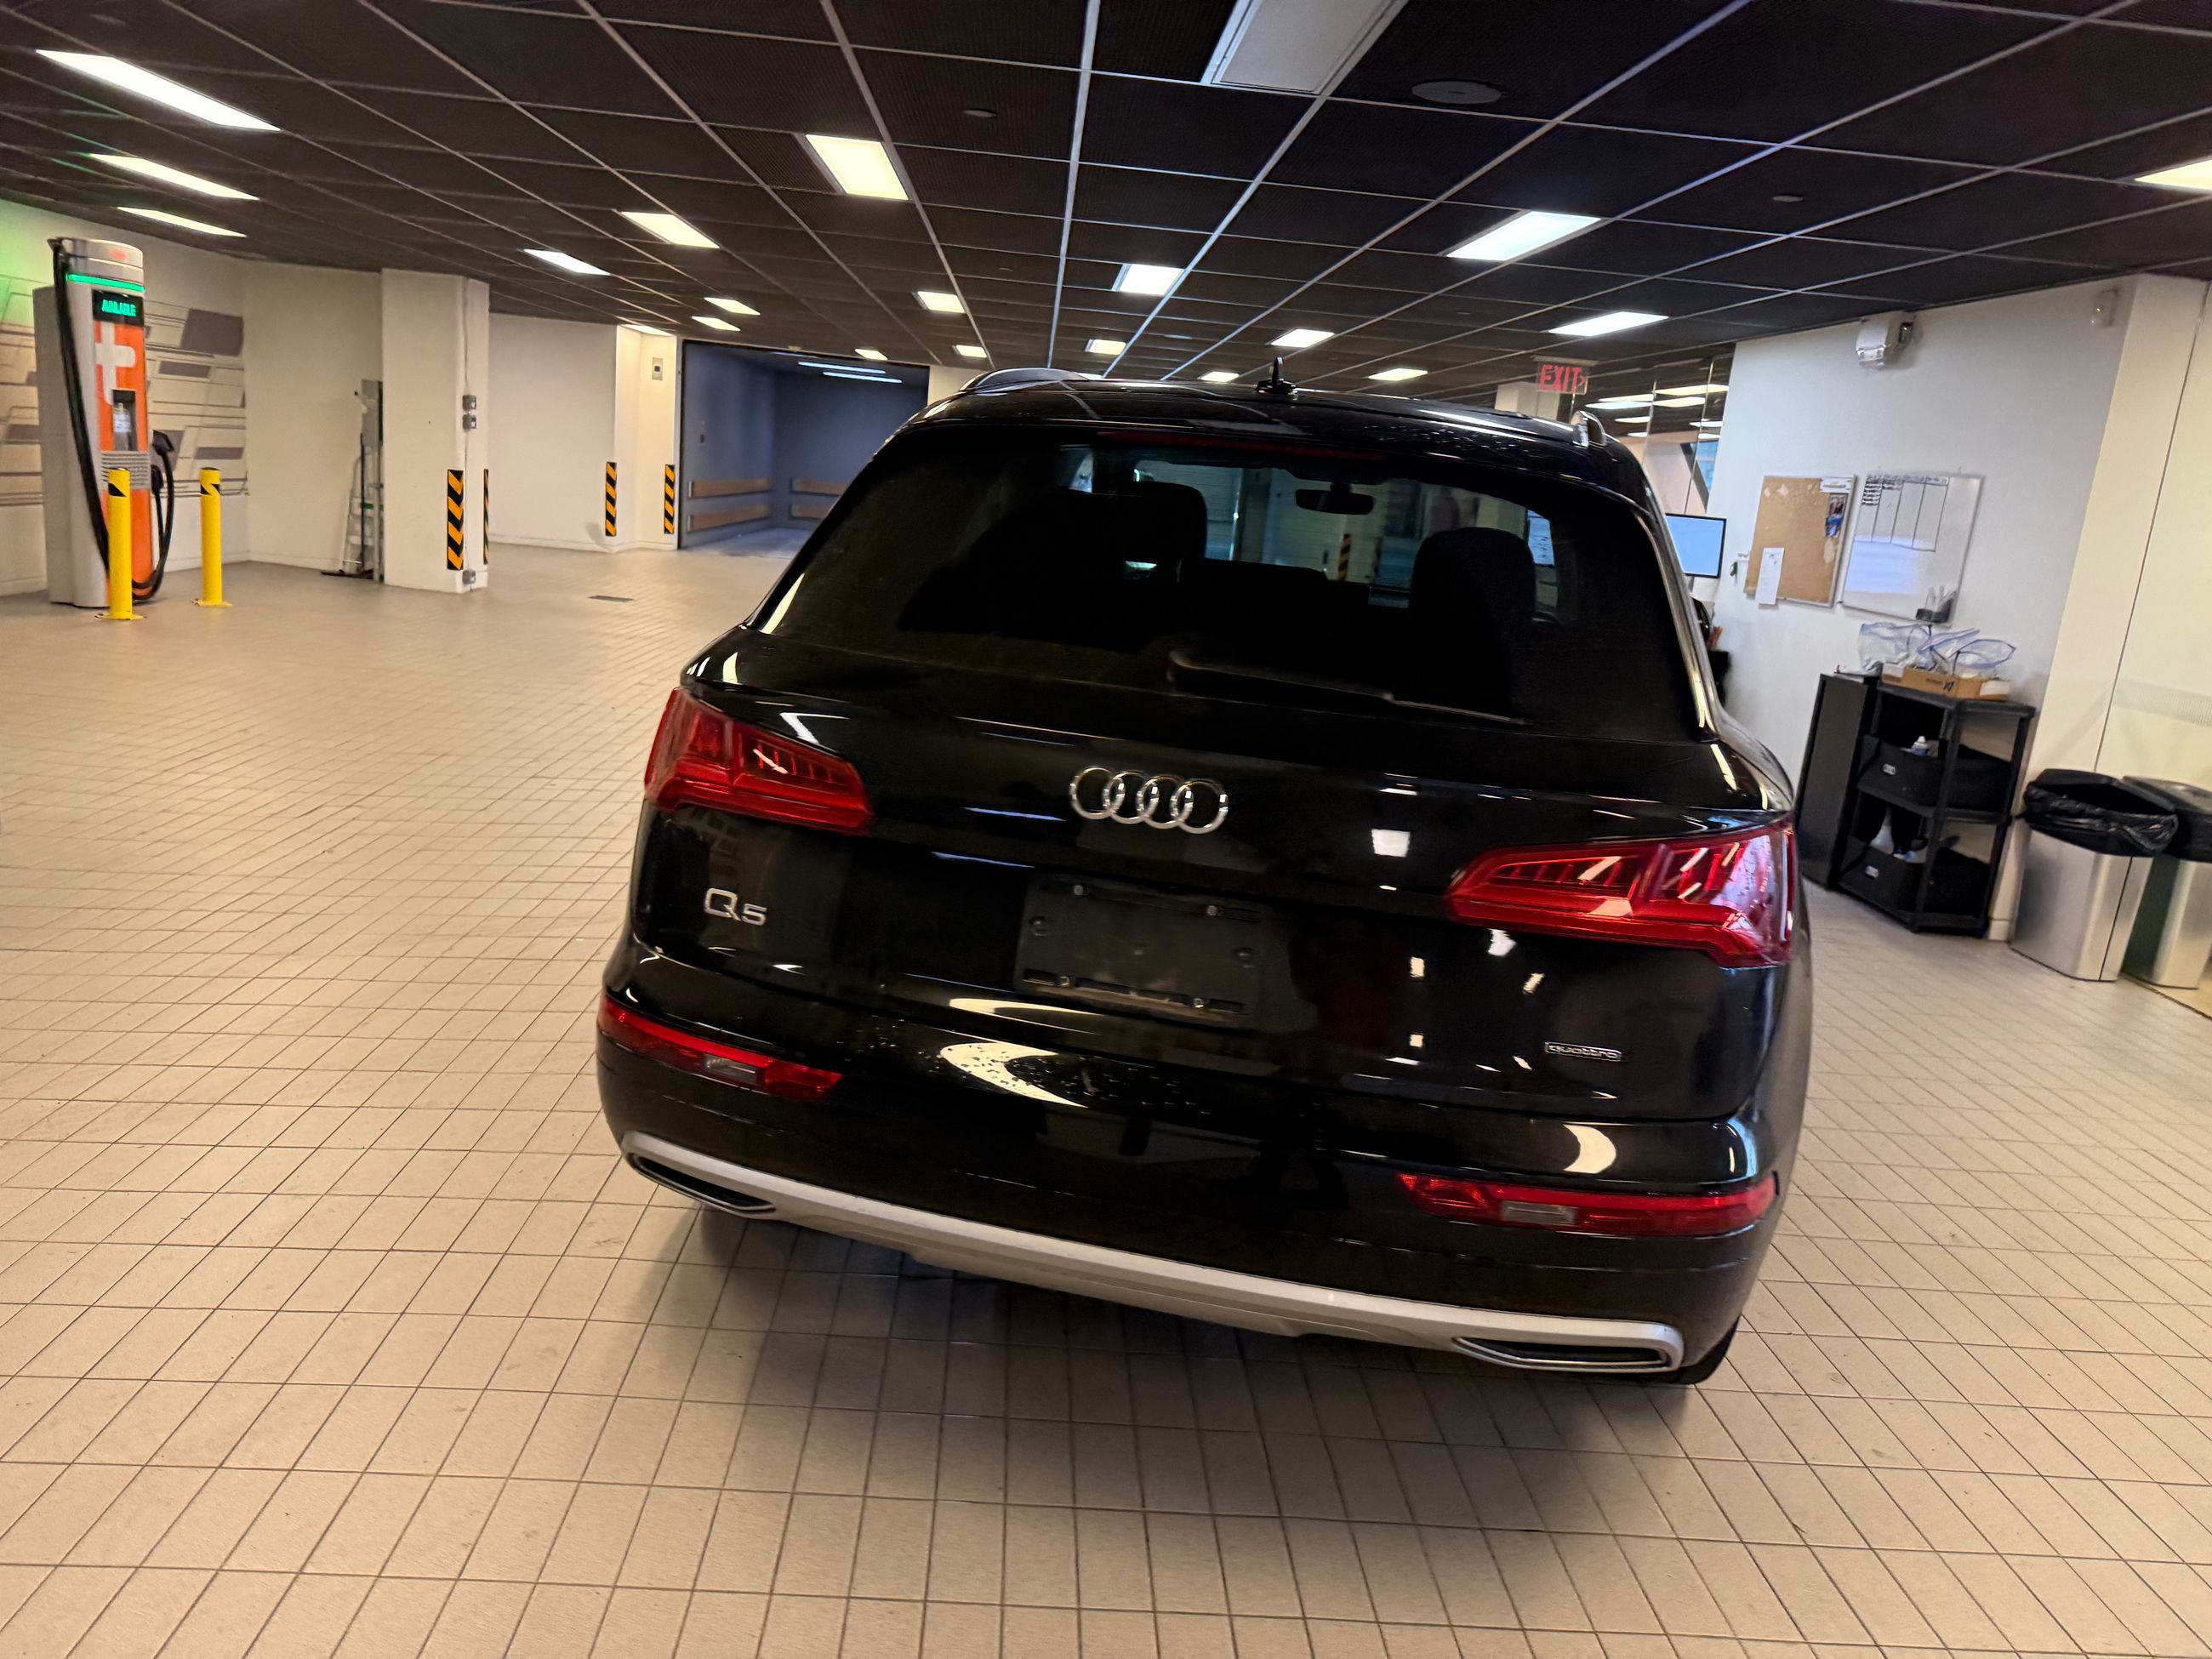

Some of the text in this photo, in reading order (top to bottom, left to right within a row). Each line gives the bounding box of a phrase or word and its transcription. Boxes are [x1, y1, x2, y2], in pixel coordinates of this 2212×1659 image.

[1539, 364, 1582, 393] EXIT
[704, 887, 768, 926] Q5
[1547, 1043, 1619, 1060] quattro
